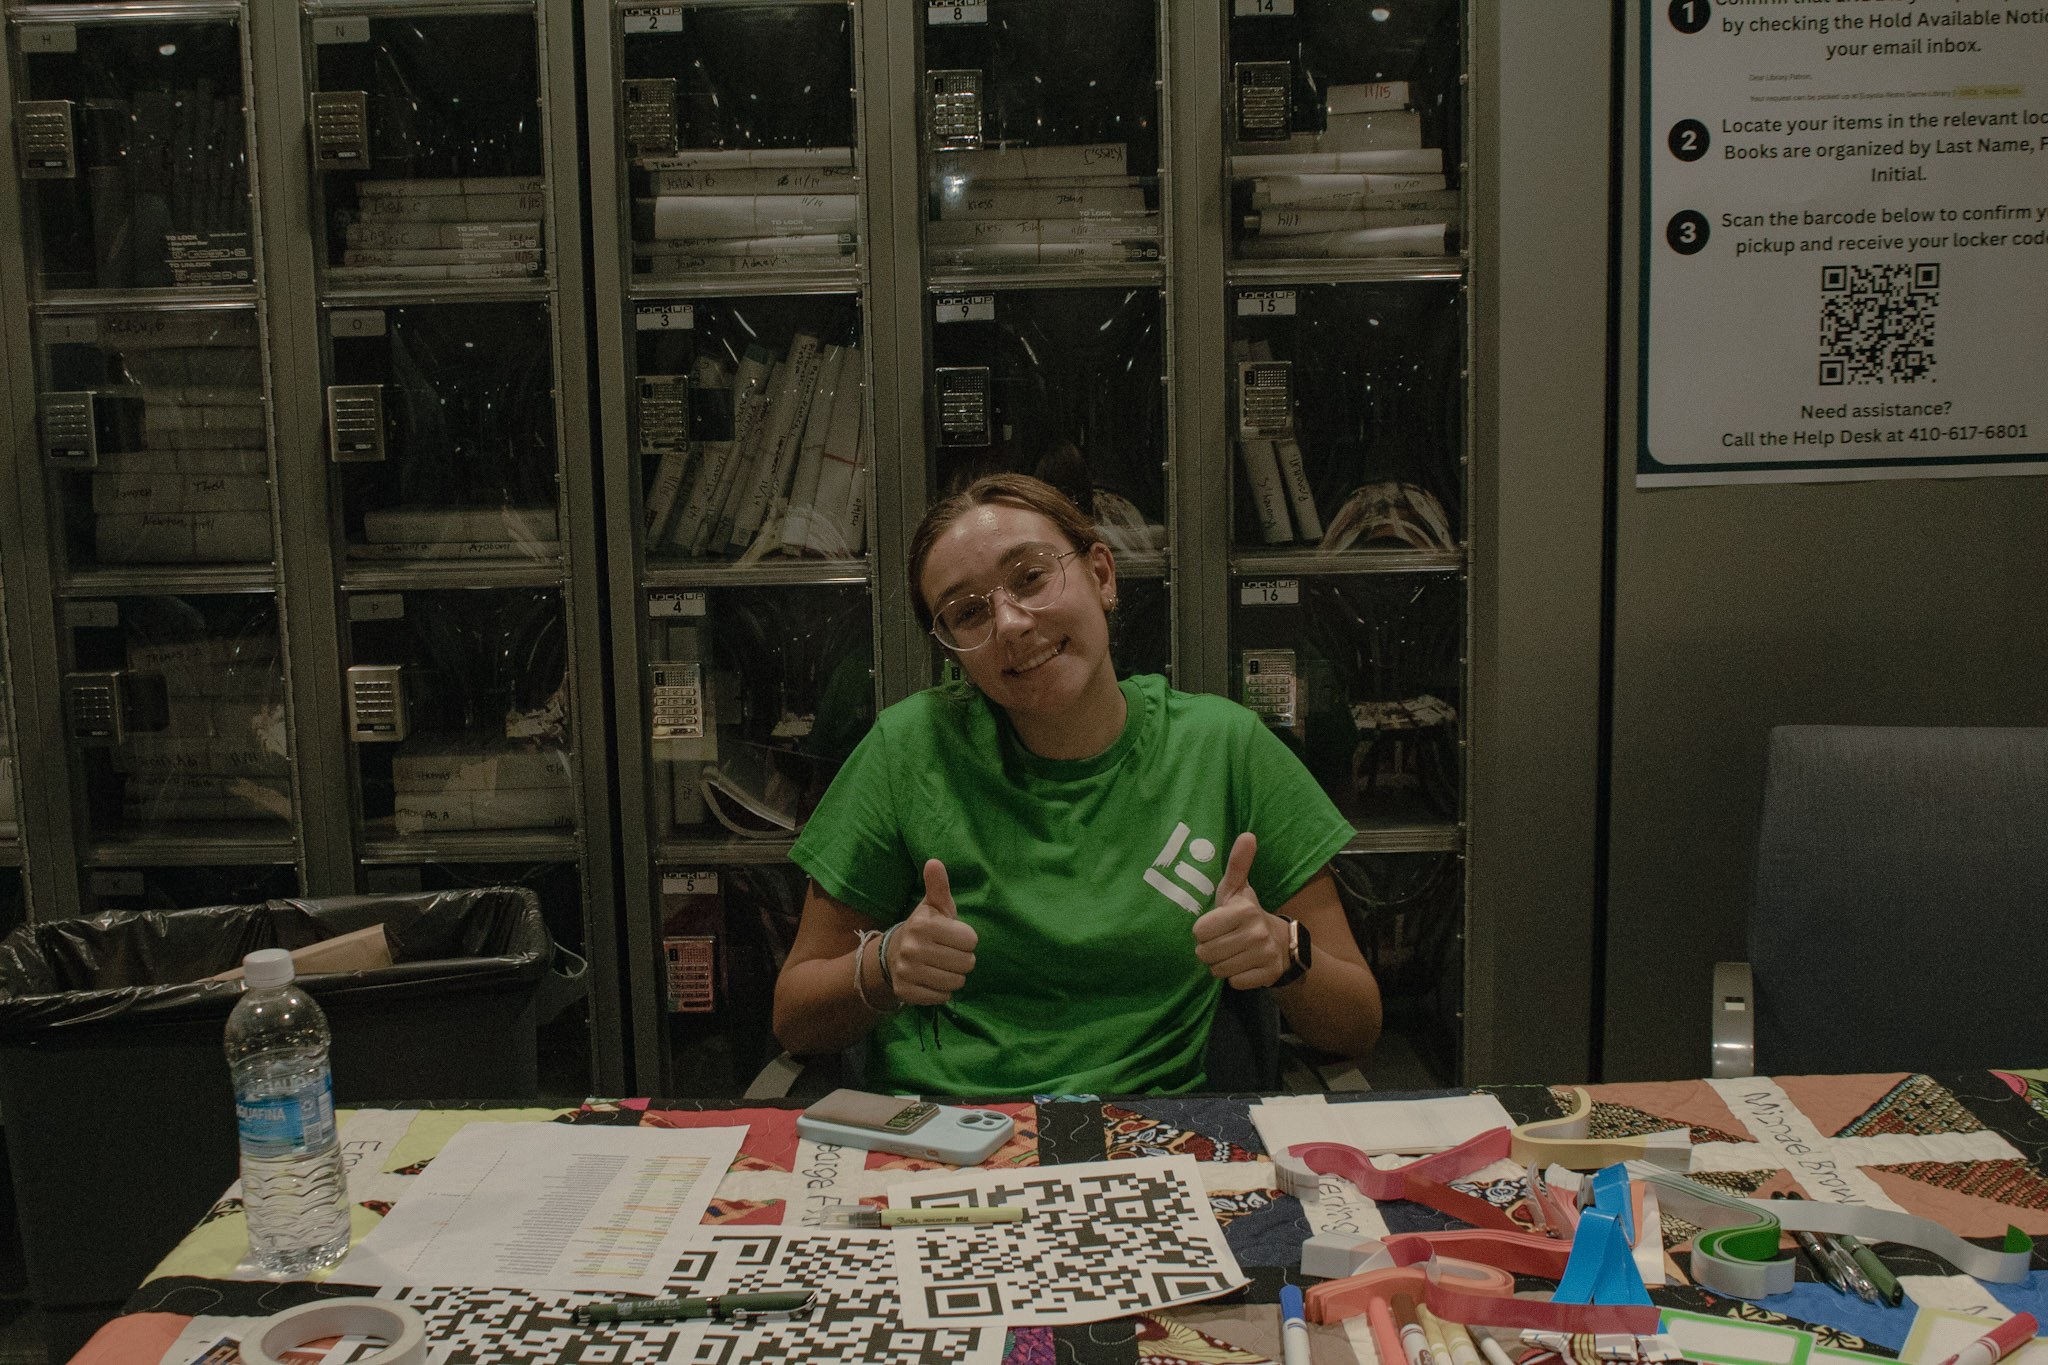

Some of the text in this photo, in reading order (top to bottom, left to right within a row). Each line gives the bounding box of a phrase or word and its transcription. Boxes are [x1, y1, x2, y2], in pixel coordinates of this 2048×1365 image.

[1257, 0, 1274, 13] 14
[1682, 1, 1695, 24] 1
[954, 8, 962, 20] 8
[650, 17, 658, 30] 2
[1722, 17, 1744, 37] by
[1749, 15, 1829, 34] checking
[1833, 14, 1864, 30] the
[1869, 12, 1912, 28] Hold
[1917, 10, 2001, 27] Available
[336, 26, 344, 37] N
[1825, 38, 1982, 60] your email inbox.
[1722, 119, 1782, 133] Locate
[1786, 119, 1828, 136] your
[1833, 115, 1883, 130] items
[1888, 113, 1904, 128] in
[1908, 113, 1939, 128] the
[1943, 111, 2018, 127] relevant
[1680, 130, 1698, 150] 2
[1724, 144, 1778, 160] Books
[1782, 146, 1811, 158] are
[1816, 140, 1904, 161] organized
[1909, 139, 1931, 158] by
[1936, 140, 1972, 154] Last
[1977, 138, 2035, 154] Name,
[1871, 166, 1927, 182] Initial.
[1722, 213, 1764, 228] Scan
[1769, 211, 1799, 226] the
[1803, 209, 1876, 225] barcode
[1882, 207, 1935, 223] below
[1939, 208, 1958, 221] to
[1962, 205, 2032, 221] confirm
[1680, 221, 1697, 244] 3
[1736, 230, 2048, 257] pickup and receive your locker cod
[961, 306, 969, 318] 9
[1260, 300, 1276, 312] 15
[353, 320, 362, 330] O
[661, 315, 669, 327] 3
[1801, 401, 1952, 419] Need assistance?
[1722, 424, 2028, 447] Call the Help Desk at 410-617-6801
[1262, 590, 1278, 601] 16
[372, 604, 379, 613] P
[673, 602, 682, 613] 4
[687, 880, 694, 892] 5
[637, 1299, 680, 1307] LOYOLA
